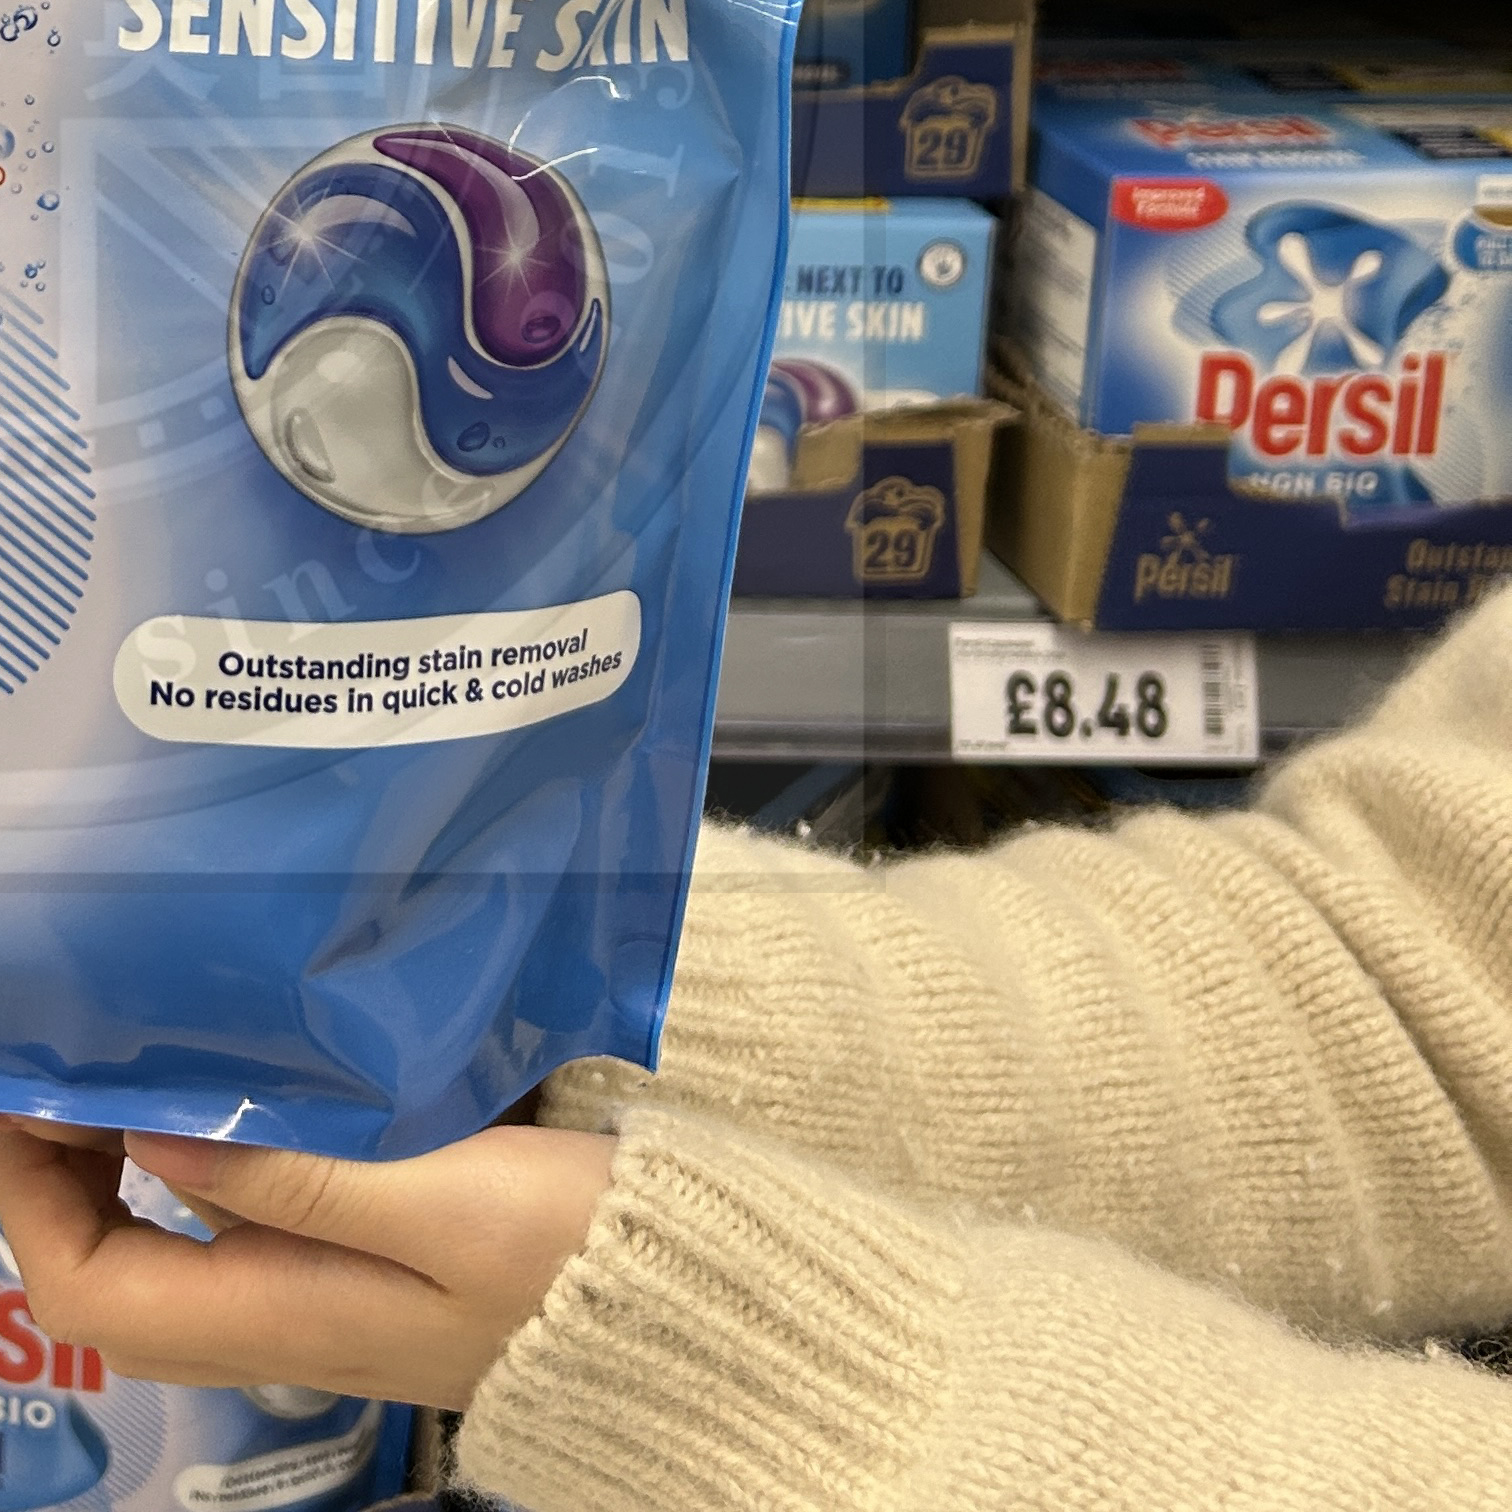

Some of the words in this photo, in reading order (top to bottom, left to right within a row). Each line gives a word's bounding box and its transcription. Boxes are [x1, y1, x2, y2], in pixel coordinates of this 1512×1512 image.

[917, 128, 969, 166] 29
[797, 264, 862, 295] NEXT
[873, 264, 905, 295] TO
[845, 301, 925, 341] SKIN
[865, 529, 918, 569] 29
[1134, 553, 1234, 604] Persil
[218, 649, 410, 680] Outstanding
[418, 644, 483, 674] stain
[490, 627, 589, 669] removal
[150, 679, 196, 709] No
[204, 684, 338, 715] residues
[347, 686, 374, 713] in
[382, 680, 458, 715] quick
[464, 678, 485, 702] &
[491, 670, 545, 701] cold
[550, 648, 622, 687] washes
[1005, 669, 1169, 739] £8.48
